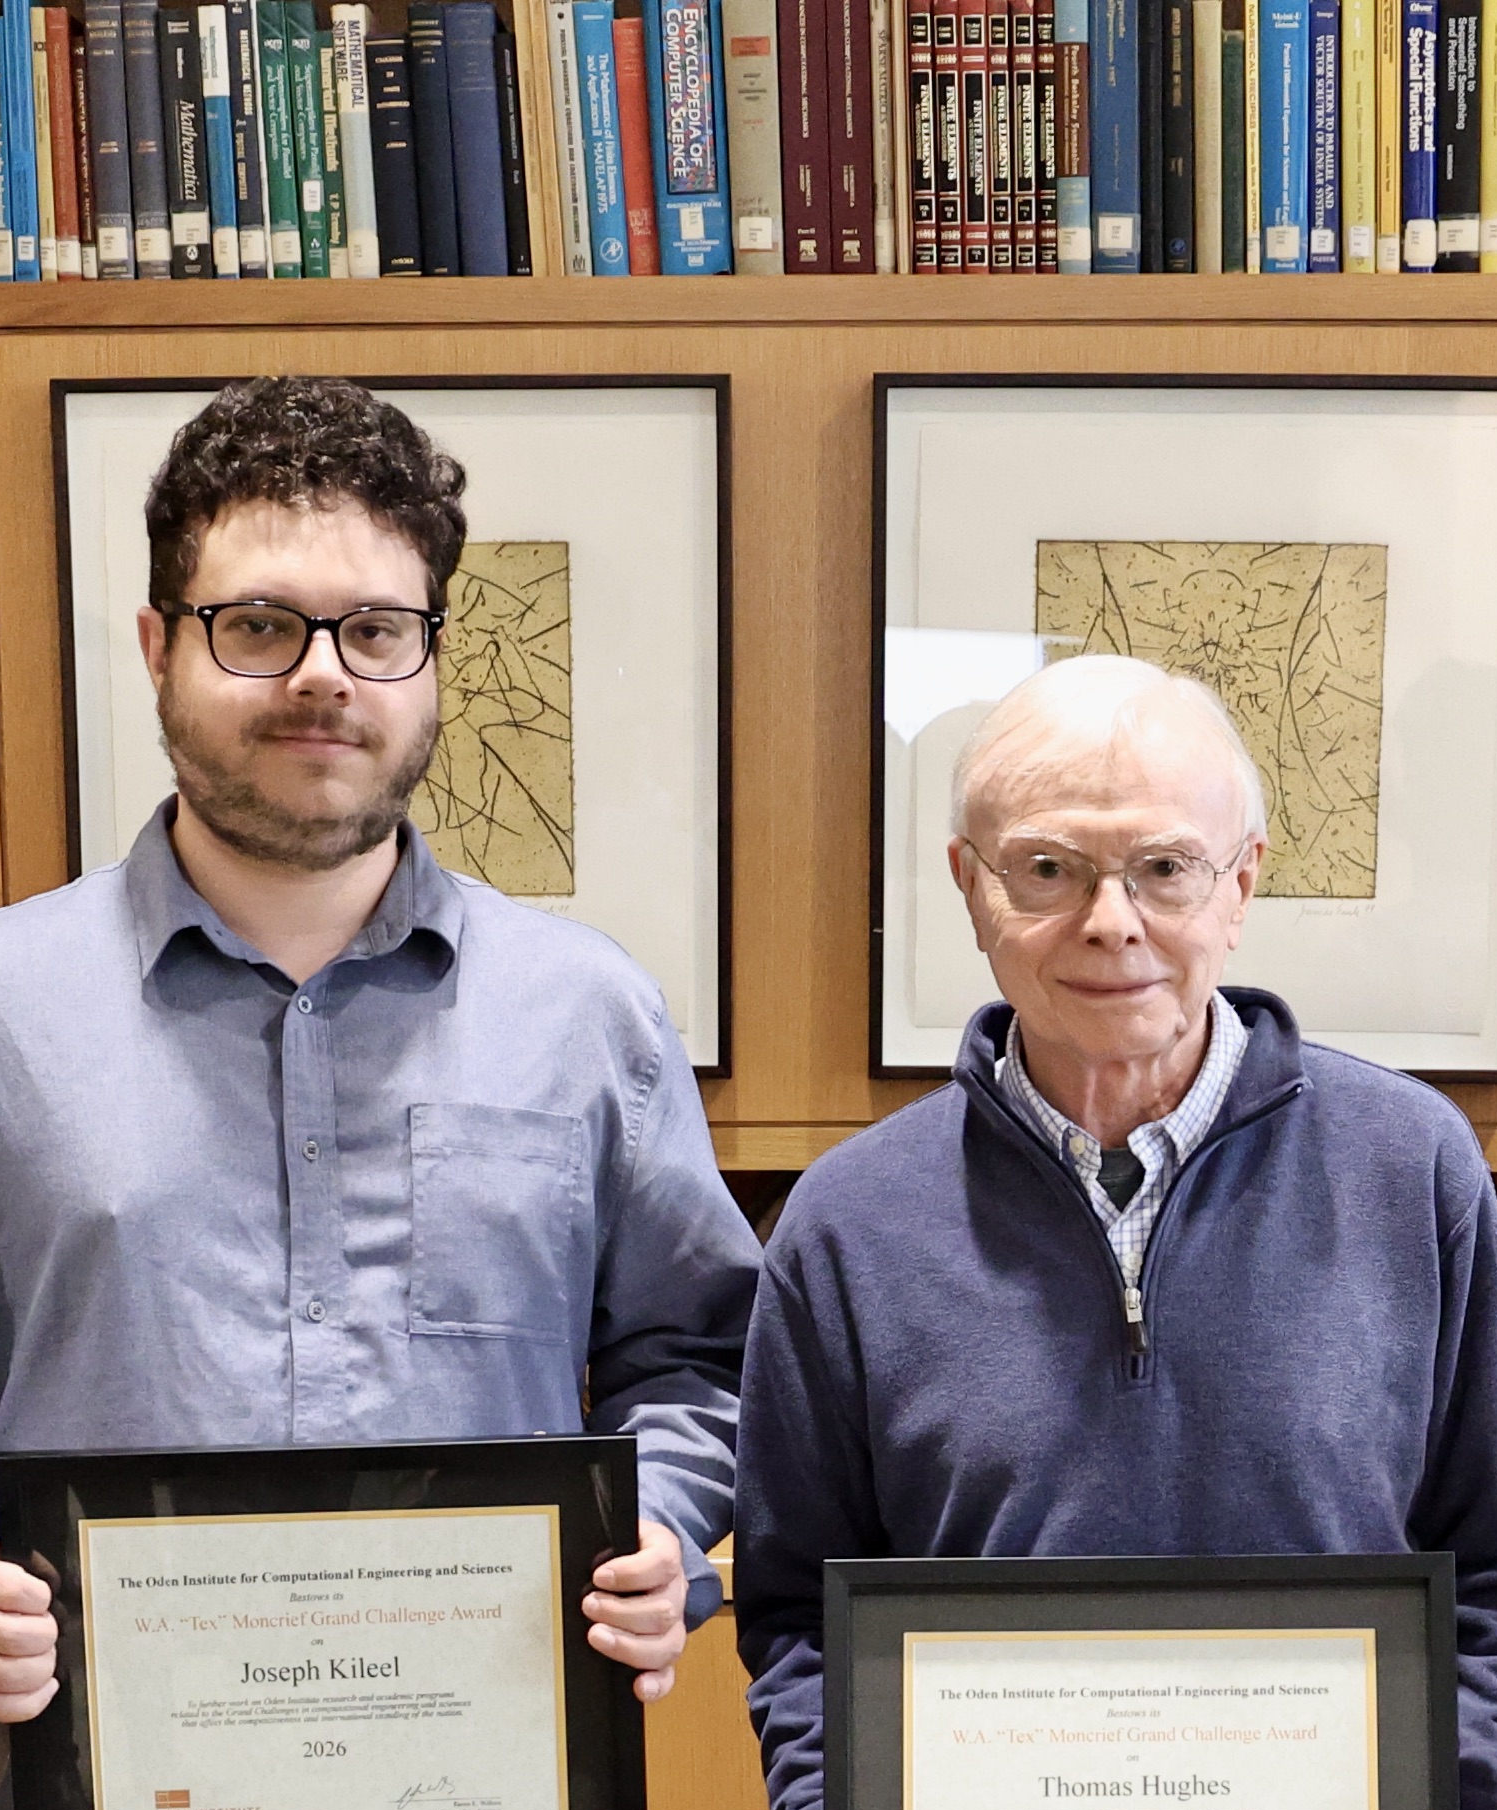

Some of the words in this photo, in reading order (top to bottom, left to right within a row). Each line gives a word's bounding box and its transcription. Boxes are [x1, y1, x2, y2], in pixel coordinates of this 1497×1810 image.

[333, 20, 348, 82] SOFTWARE
[348, 20, 364, 108] MATHEMATICAL
[666, 9, 684, 103] COMPUTER
[1408, 27, 1422, 80] Special
[684, 8, 700, 139] ENCYCLOPEDIA
[1422, 31, 1436, 122] Asymptotics
[1409, 83, 1423, 152] Functions
[179, 101, 200, 200] Mathematica
[670, 107, 687, 177] SCIENCE
[1424, 124, 1436, 152] and
[690, 144, 703, 166] OF
[118, 1577, 142, 1588] The
[146, 1576, 179, 1587] Oden
[183, 1573, 236, 1586] Institute
[240, 1573, 258, 1583] for
[262, 1568, 354, 1582] Computational
[357, 1565, 431, 1580] Engineering
[435, 1564, 457, 1575] and
[461, 1562, 512, 1574] Sciences
[290, 1591, 329, 1603] Bestows
[332, 1590, 343, 1600] its
[134, 1617, 174, 1633] W.A.
[233, 1610, 307, 1628] Moncrief
[311, 1608, 360, 1625] Grand
[365, 1606, 445, 1625] Challenge
[450, 1604, 502, 1620] Award
[310, 1638, 323, 1646] on
[240, 1659, 320, 1686] Joseph
[329, 1656, 400, 1679] Kileel
[938, 1690, 962, 1700] The
[965, 1689, 997, 1699] Oden
[1002, 1688, 1055, 1699] Institute
[1059, 1688, 1076, 1698] for
[1080, 1685, 1171, 1700] Computational
[1175, 1685, 1248, 1699] Engineering
[1252, 1685, 1274, 1695] and
[1278, 1685, 1329, 1695] Sciences
[1106, 1708, 1145, 1718] Bestows
[1149, 1708, 1160, 1717] its
[952, 1729, 990, 1744] W.A.
[1048, 1726, 1122, 1743] Moncrief
[1126, 1726, 1175, 1742] Grand
[1180, 1726, 1261, 1744] Challenge
[1265, 1725, 1317, 1740] Award
[302, 1740, 347, 1758] 2026
[1126, 1754, 1138, 1762] on
[1038, 1776, 1132, 1798] Thomas
[1141, 1775, 1230, 1801] Hughes
